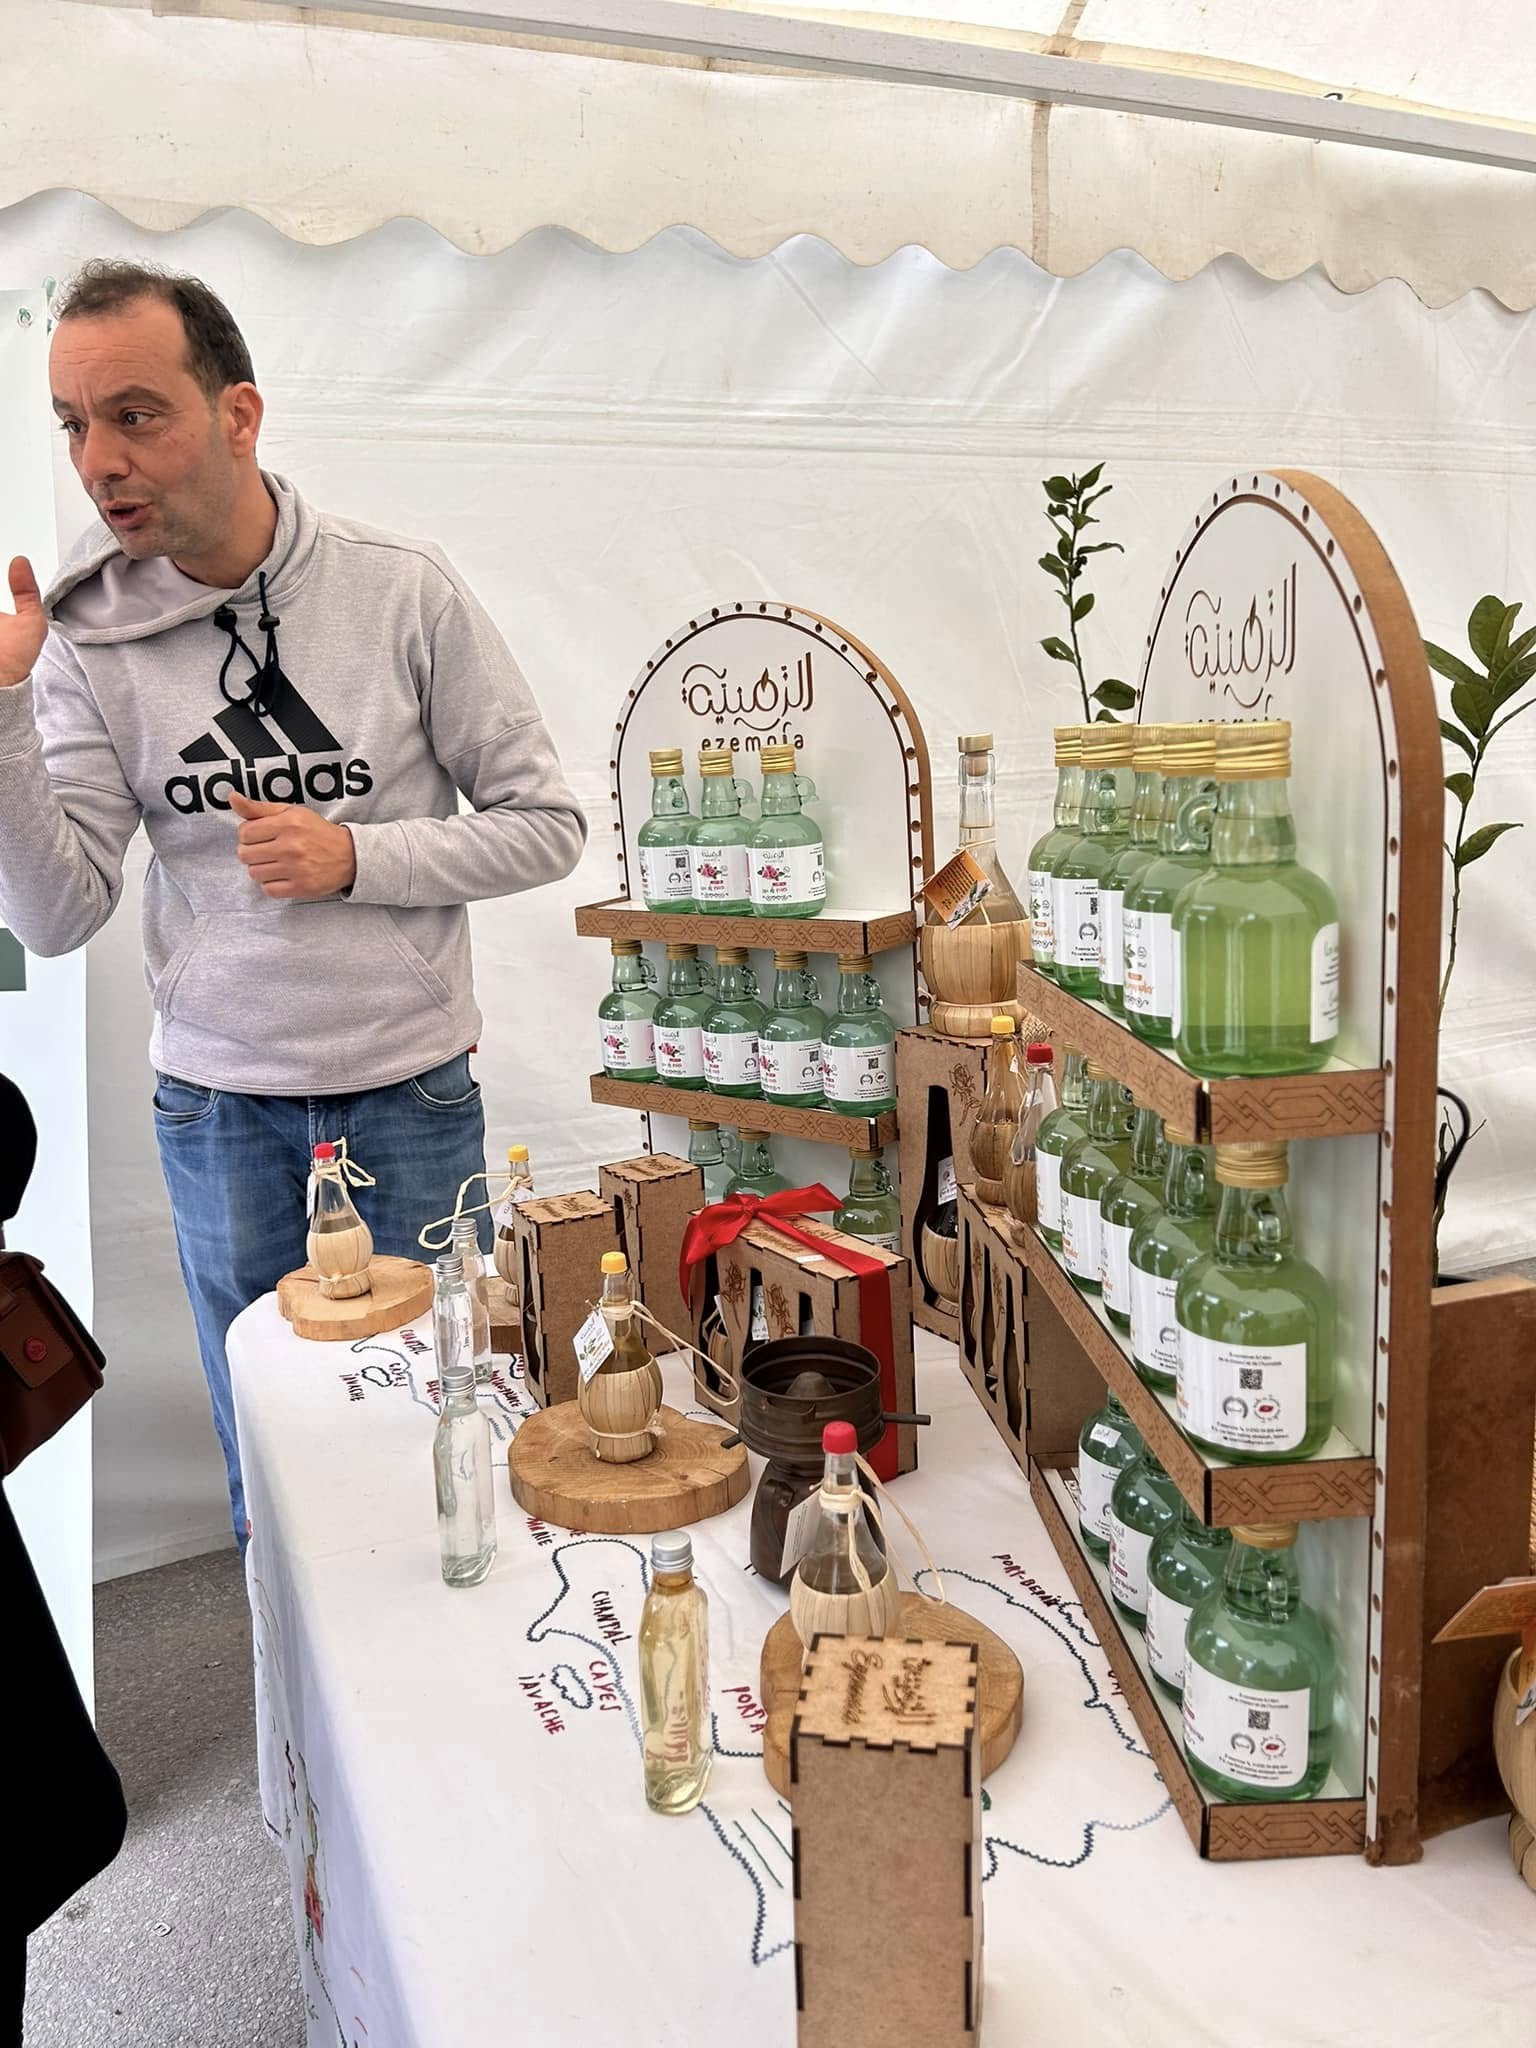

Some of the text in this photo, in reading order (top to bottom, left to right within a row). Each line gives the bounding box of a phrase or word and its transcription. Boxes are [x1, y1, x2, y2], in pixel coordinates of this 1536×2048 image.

[165, 755, 373, 814] adidas
[592, 1591, 632, 1646] CHANTAL
[589, 1660, 622, 1712] CAYES
